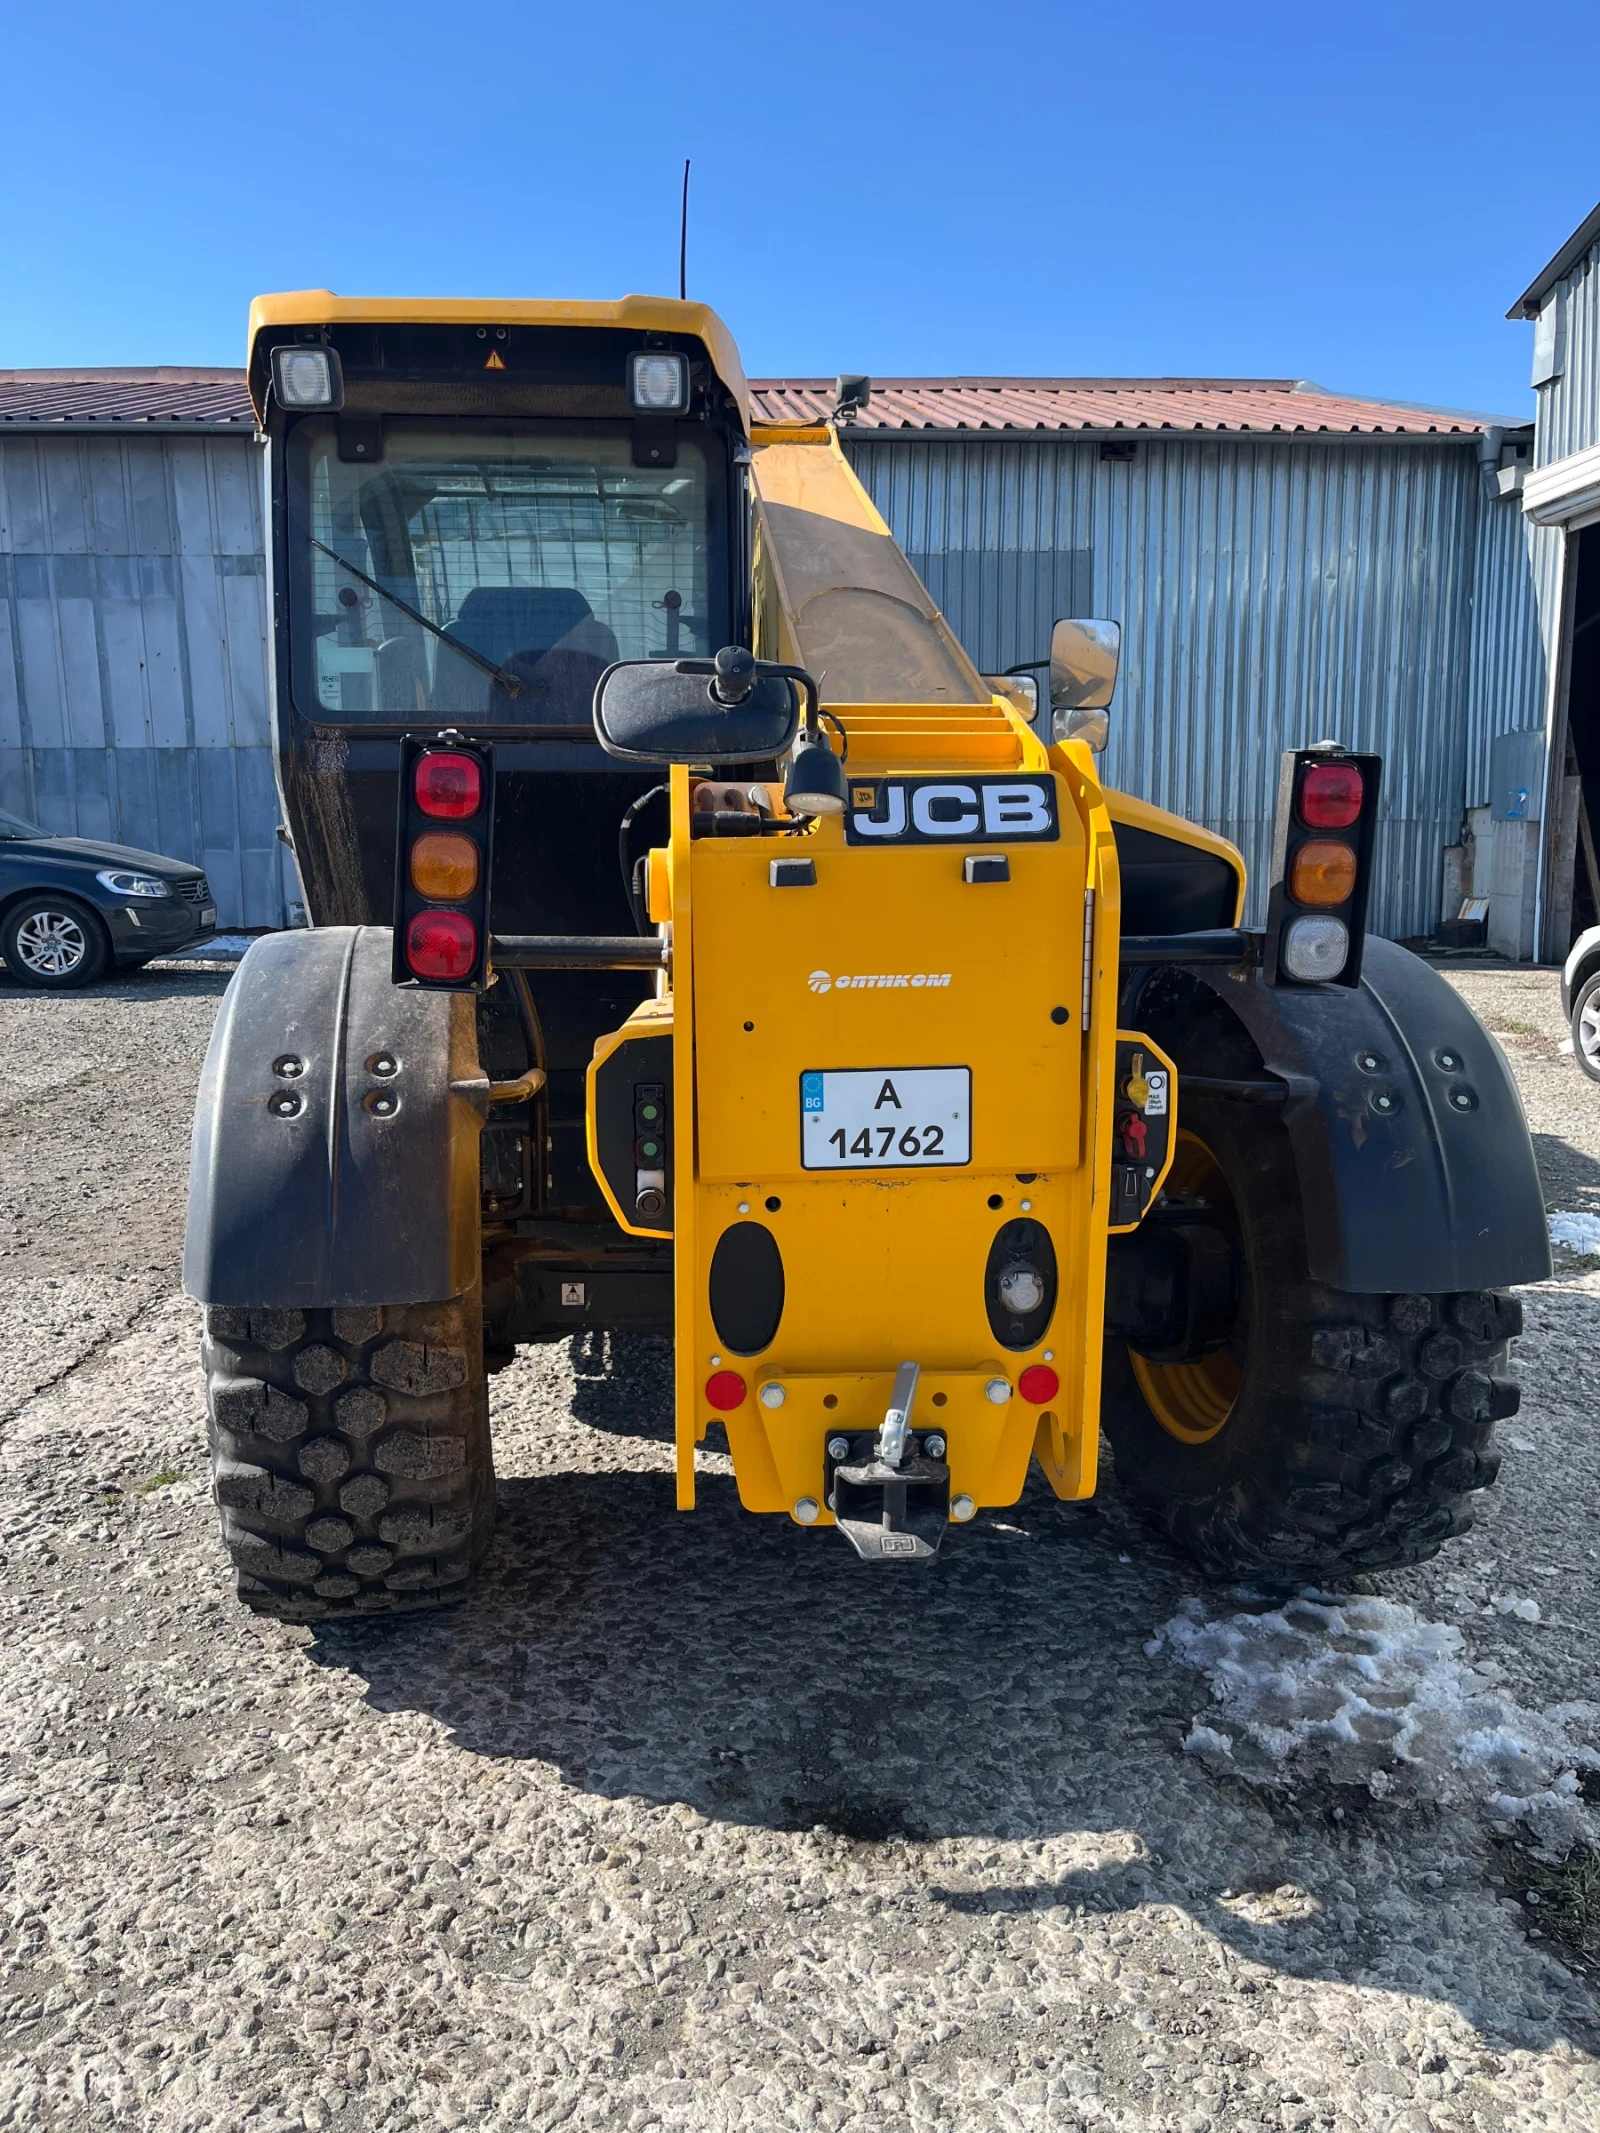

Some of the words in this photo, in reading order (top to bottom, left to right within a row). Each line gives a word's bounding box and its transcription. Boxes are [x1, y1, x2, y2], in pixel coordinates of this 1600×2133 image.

[853, 784, 1051, 836] JCB
[835, 974, 952, 988] ОПТИКОМ
[805, 1097, 821, 1108] BG
[874, 1078, 902, 1109] A
[829, 1125, 944, 1158] 14762
